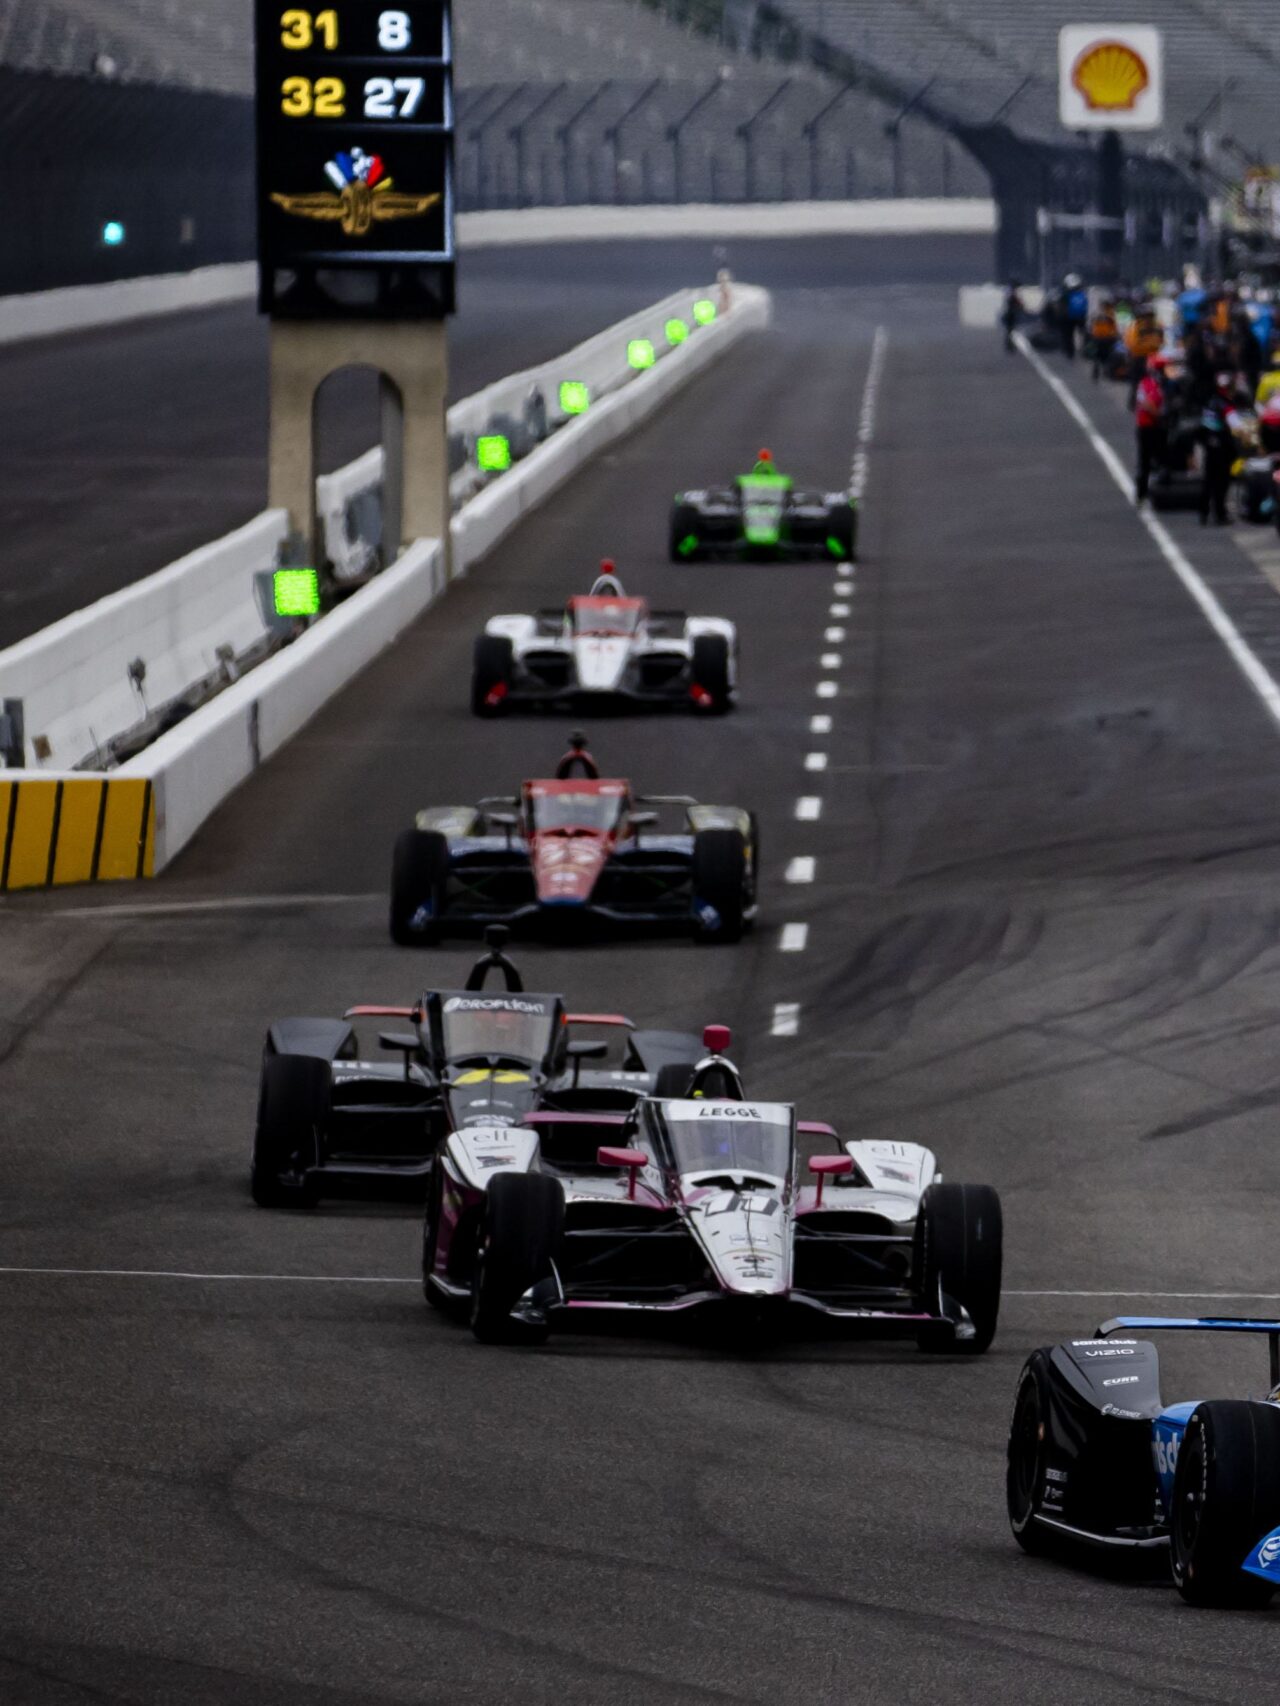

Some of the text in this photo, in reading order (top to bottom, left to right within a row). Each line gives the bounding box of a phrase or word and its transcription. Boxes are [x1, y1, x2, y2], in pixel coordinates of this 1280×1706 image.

[281, 9, 411, 51] 31 8
[282, 76, 425, 118] 32 27
[699, 1107, 762, 1119] LEGGE
